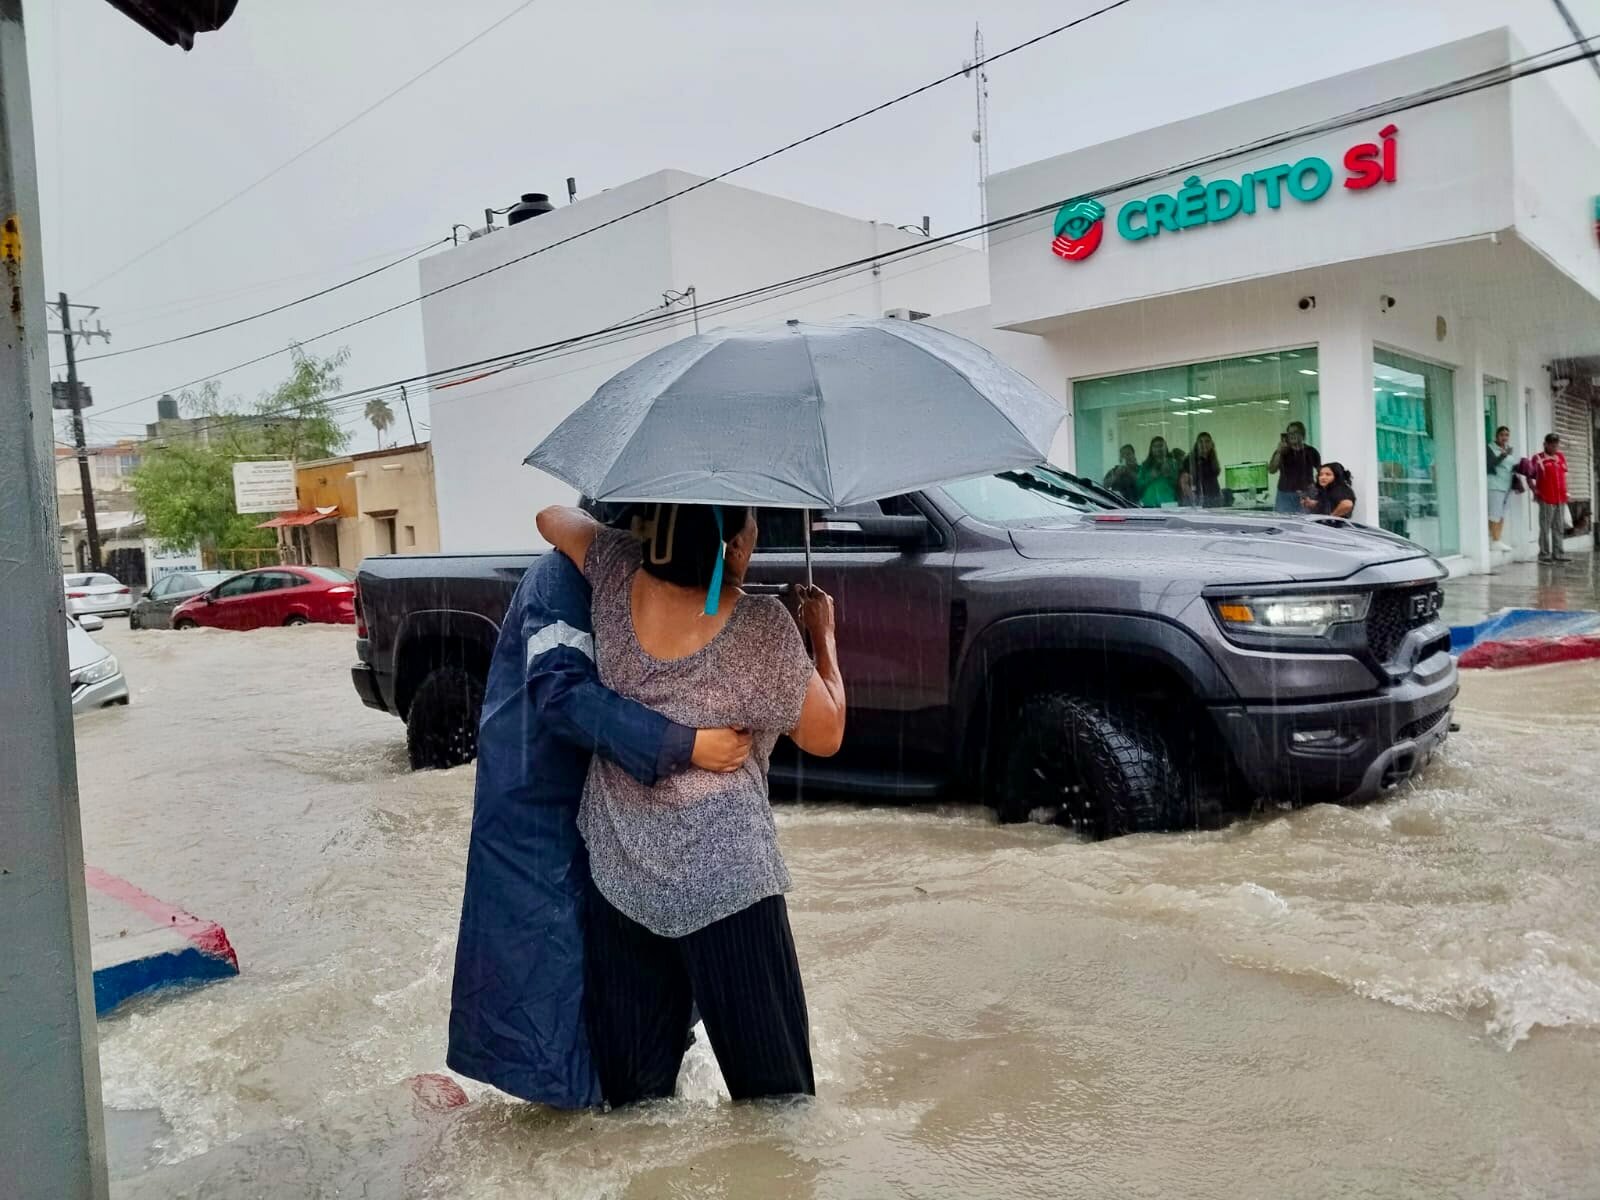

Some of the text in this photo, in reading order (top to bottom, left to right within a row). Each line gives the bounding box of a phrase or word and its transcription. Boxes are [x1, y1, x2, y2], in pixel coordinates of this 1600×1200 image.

[1117, 123, 1399, 241] CRÉDITO SÍ
[1410, 589, 1443, 620] RA
